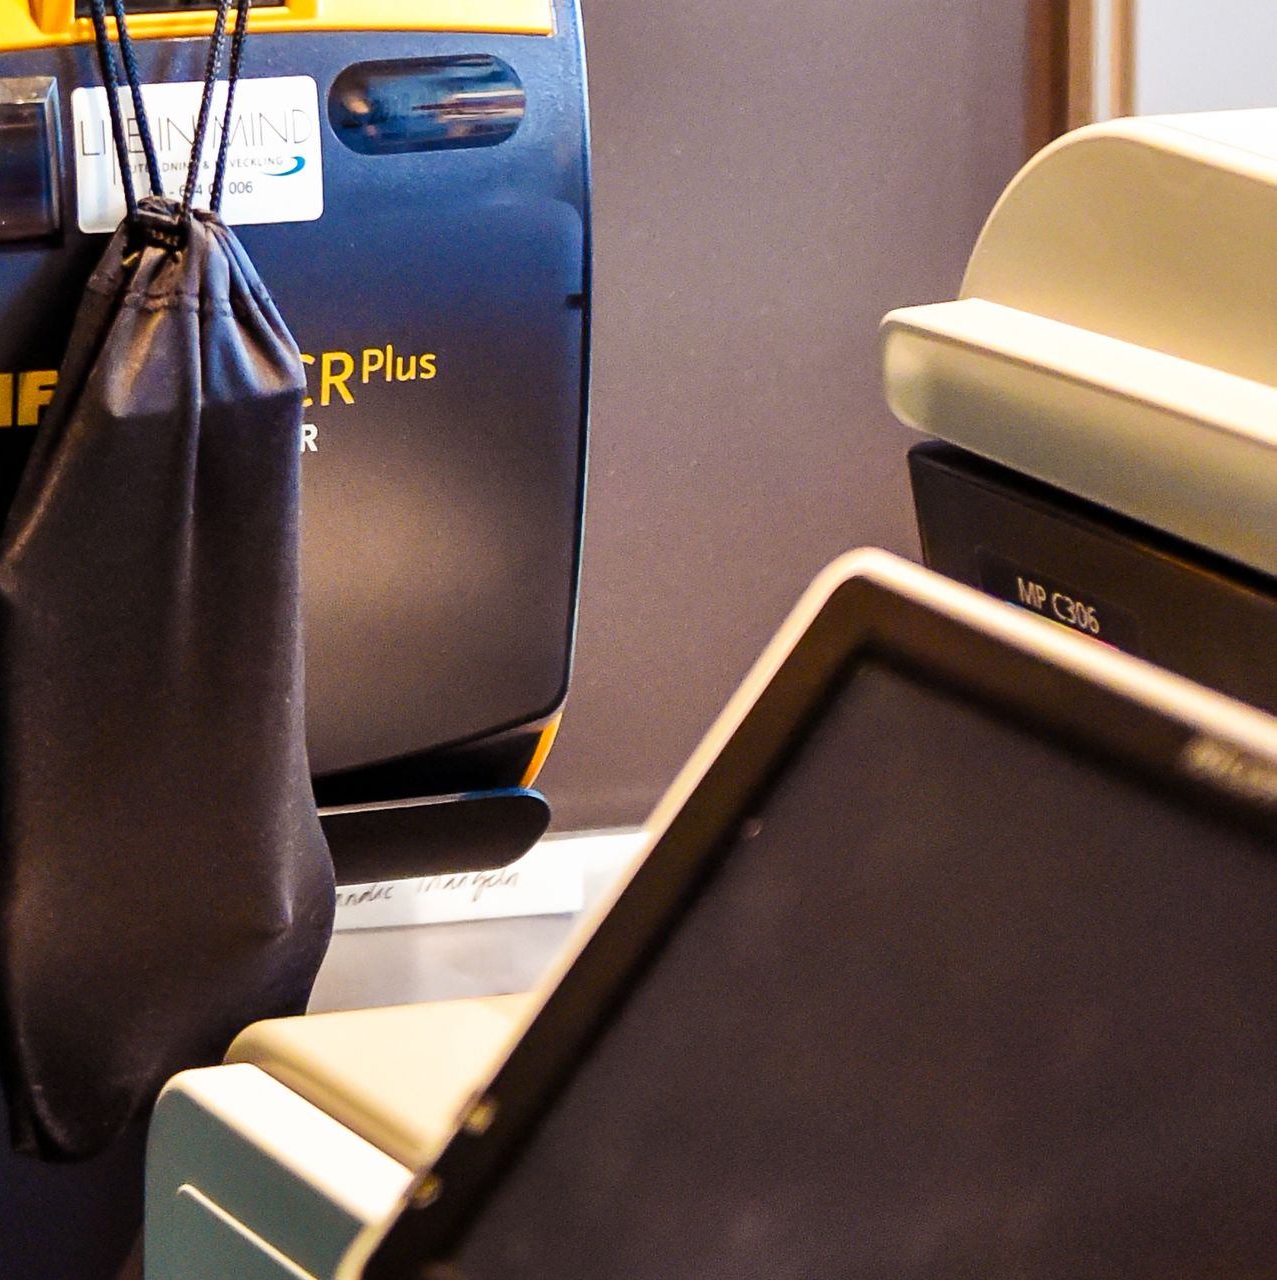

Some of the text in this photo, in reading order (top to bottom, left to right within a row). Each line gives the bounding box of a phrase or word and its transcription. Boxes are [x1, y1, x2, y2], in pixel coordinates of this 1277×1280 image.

[158, 115, 197, 151] IN
[212, 109, 314, 150] MIND
[228, 180, 254, 195] 006
[361, 343, 438, 385] Plus
[1017, 576, 1100, 634] MP C306
